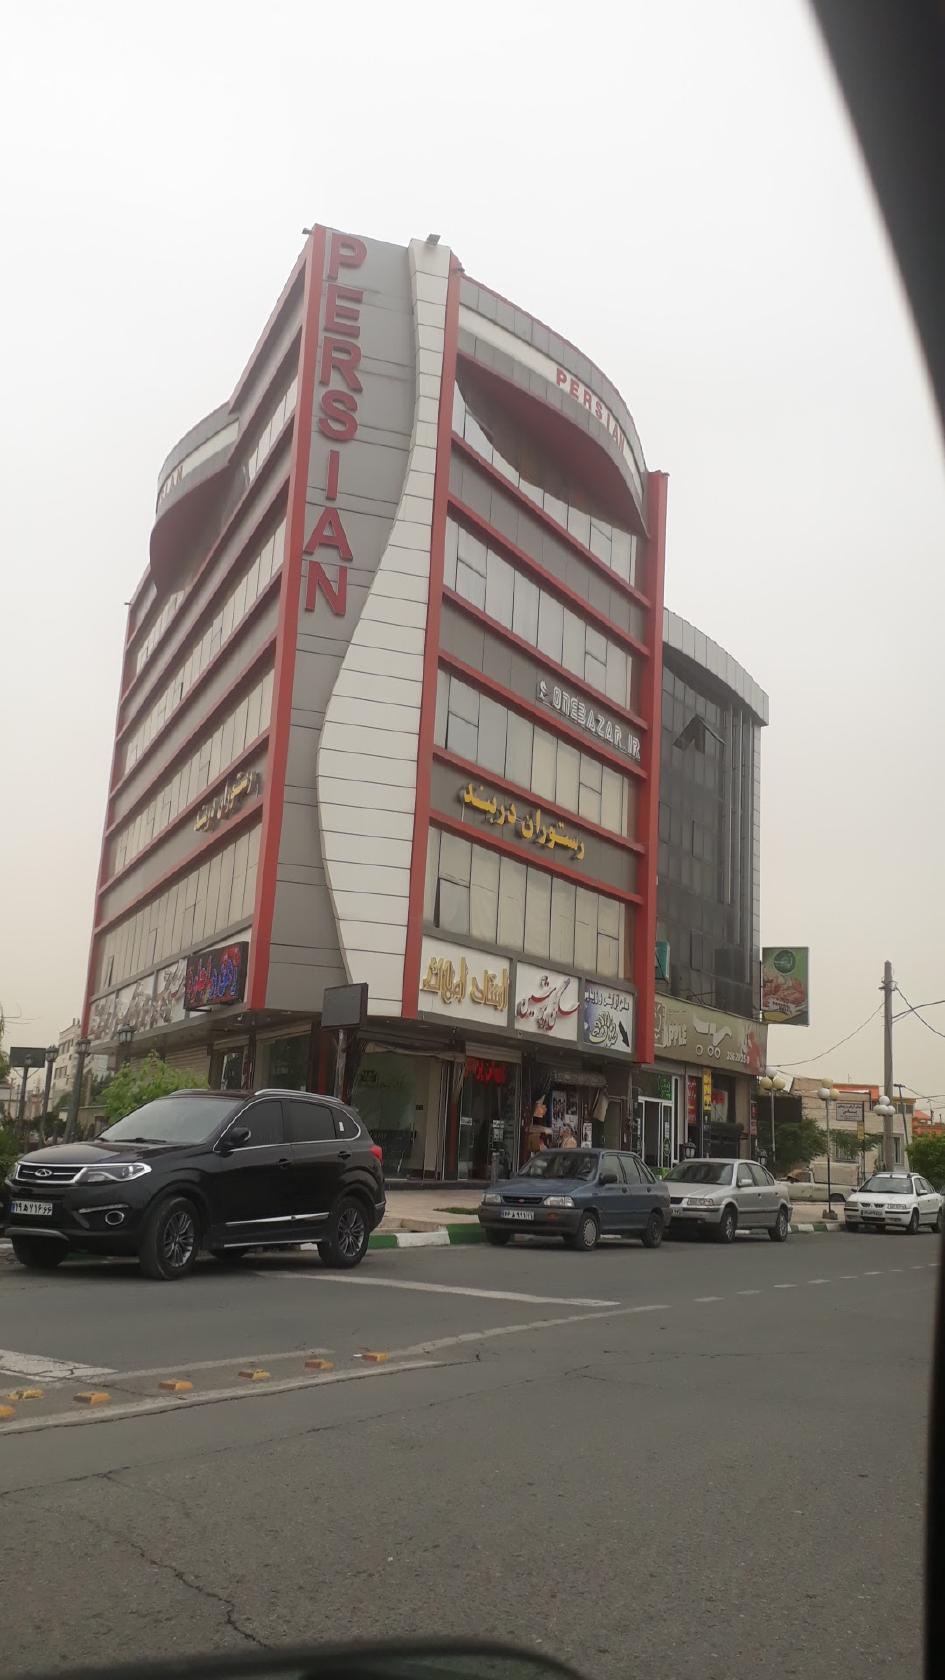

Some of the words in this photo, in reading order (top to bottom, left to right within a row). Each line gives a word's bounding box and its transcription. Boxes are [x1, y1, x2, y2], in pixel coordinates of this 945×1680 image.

[304, 232, 367, 616] PERSIAN
[556, 367, 625, 454] PERSIAN
[463, 783, 517, 825] دربند
[520, 808, 584, 861] رستوران
[422, 956, 467, 1005] املاک
